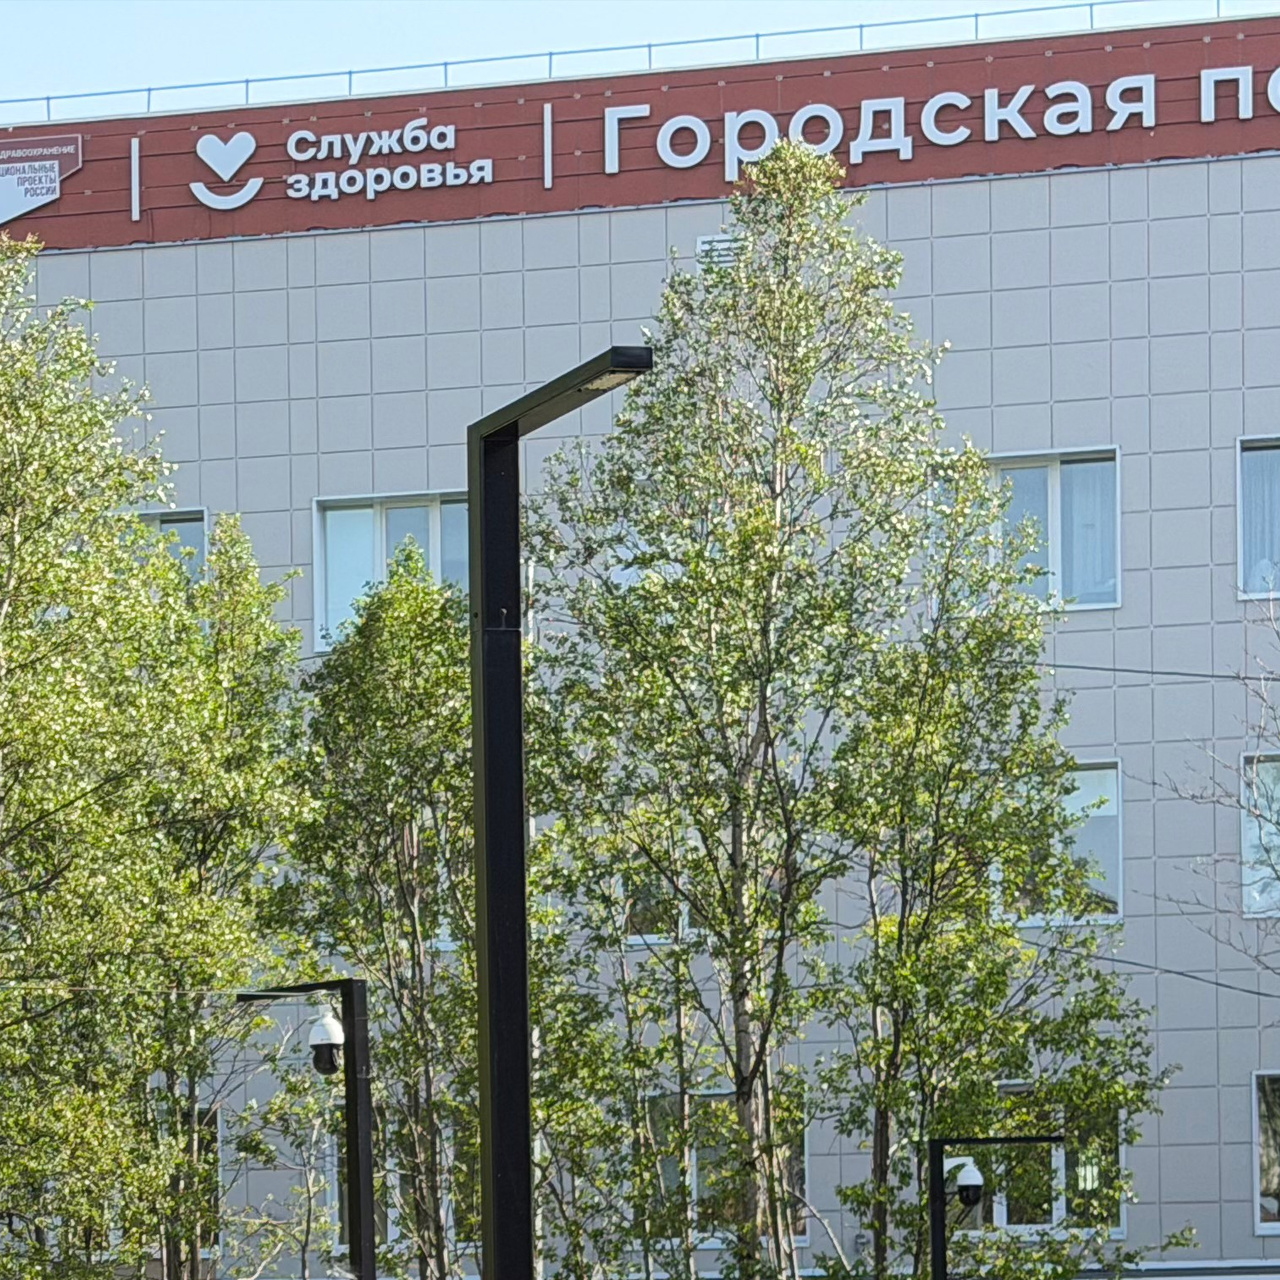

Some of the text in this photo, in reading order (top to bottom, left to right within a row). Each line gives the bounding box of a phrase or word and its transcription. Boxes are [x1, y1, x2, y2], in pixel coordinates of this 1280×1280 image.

[286, 117, 456, 166] Служба
[604, 65, 1280, 182] Городская п
[17, 174, 57, 188] ПРОЕКТЫ
[24, 187, 57, 198] РОССИИ
[286, 158, 494, 201] здоровья
